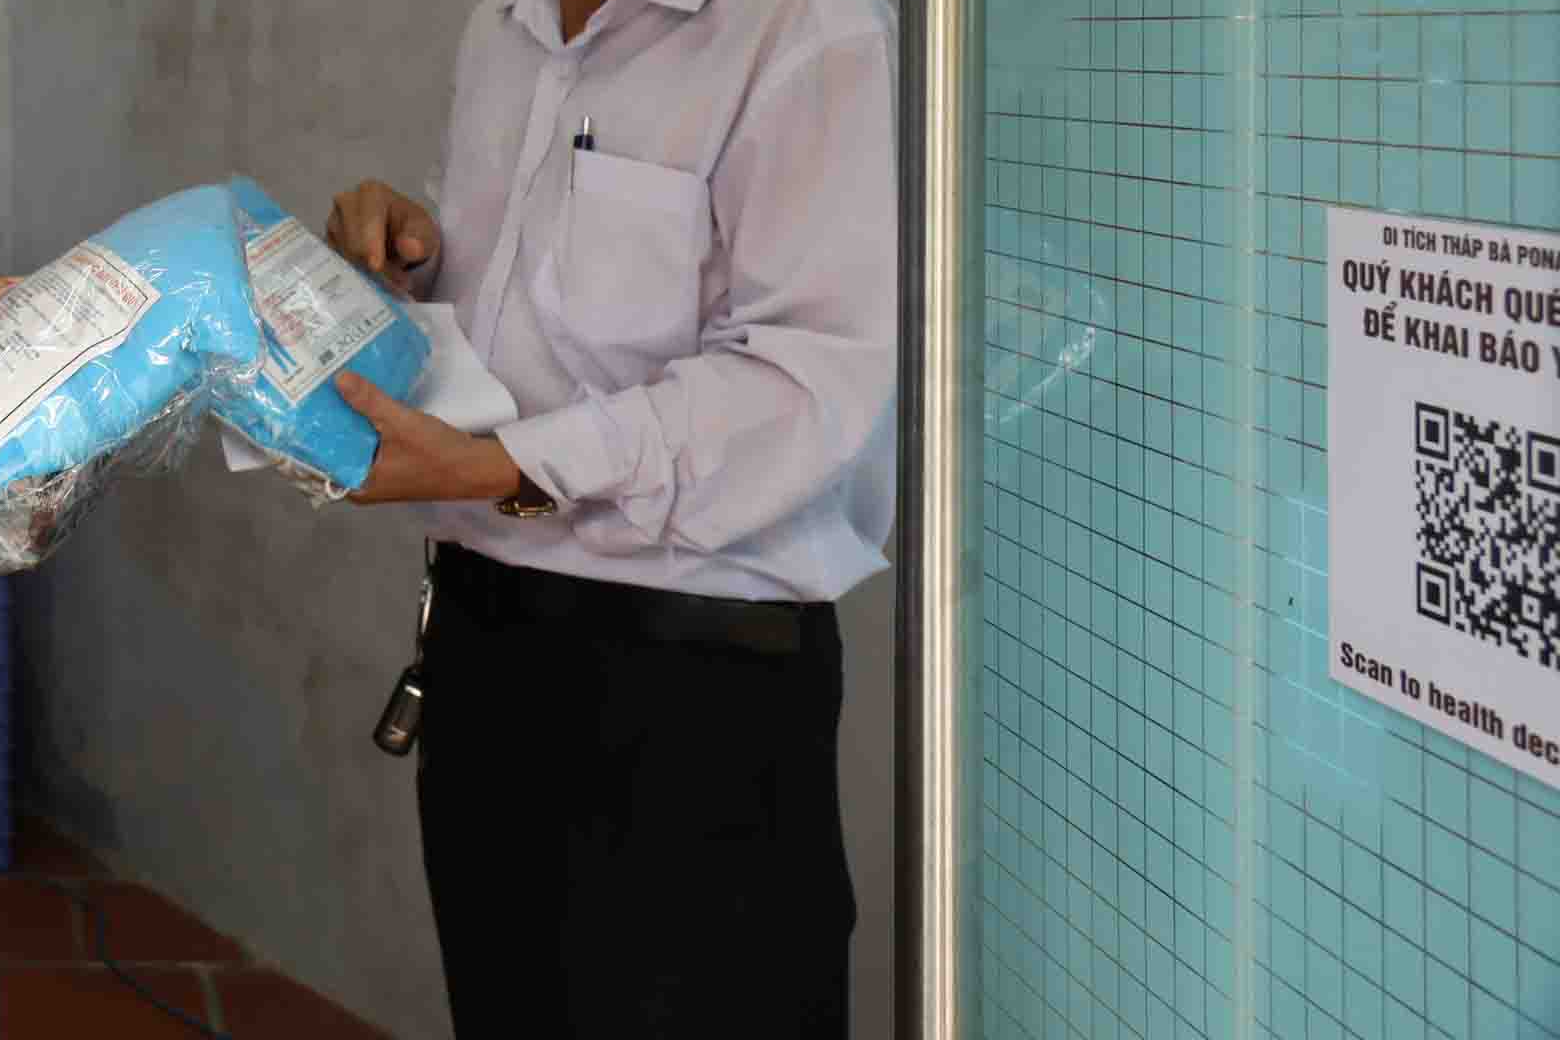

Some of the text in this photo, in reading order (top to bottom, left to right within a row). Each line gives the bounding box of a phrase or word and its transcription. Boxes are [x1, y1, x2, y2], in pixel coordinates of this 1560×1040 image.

[1402, 225, 1437, 253] TÍCH
[1441, 233, 1483, 259] THÁP
[1488, 238, 1511, 265] BÀ
[1342, 258, 1390, 296] QUÝ
[1399, 269, 1493, 316] KHÁCH
[1363, 301, 1397, 343] ĐỂ
[1404, 315, 1469, 358] KHAI
[1479, 329, 1540, 375] BÁO
[1340, 641, 1560, 766] Scan to health dec
